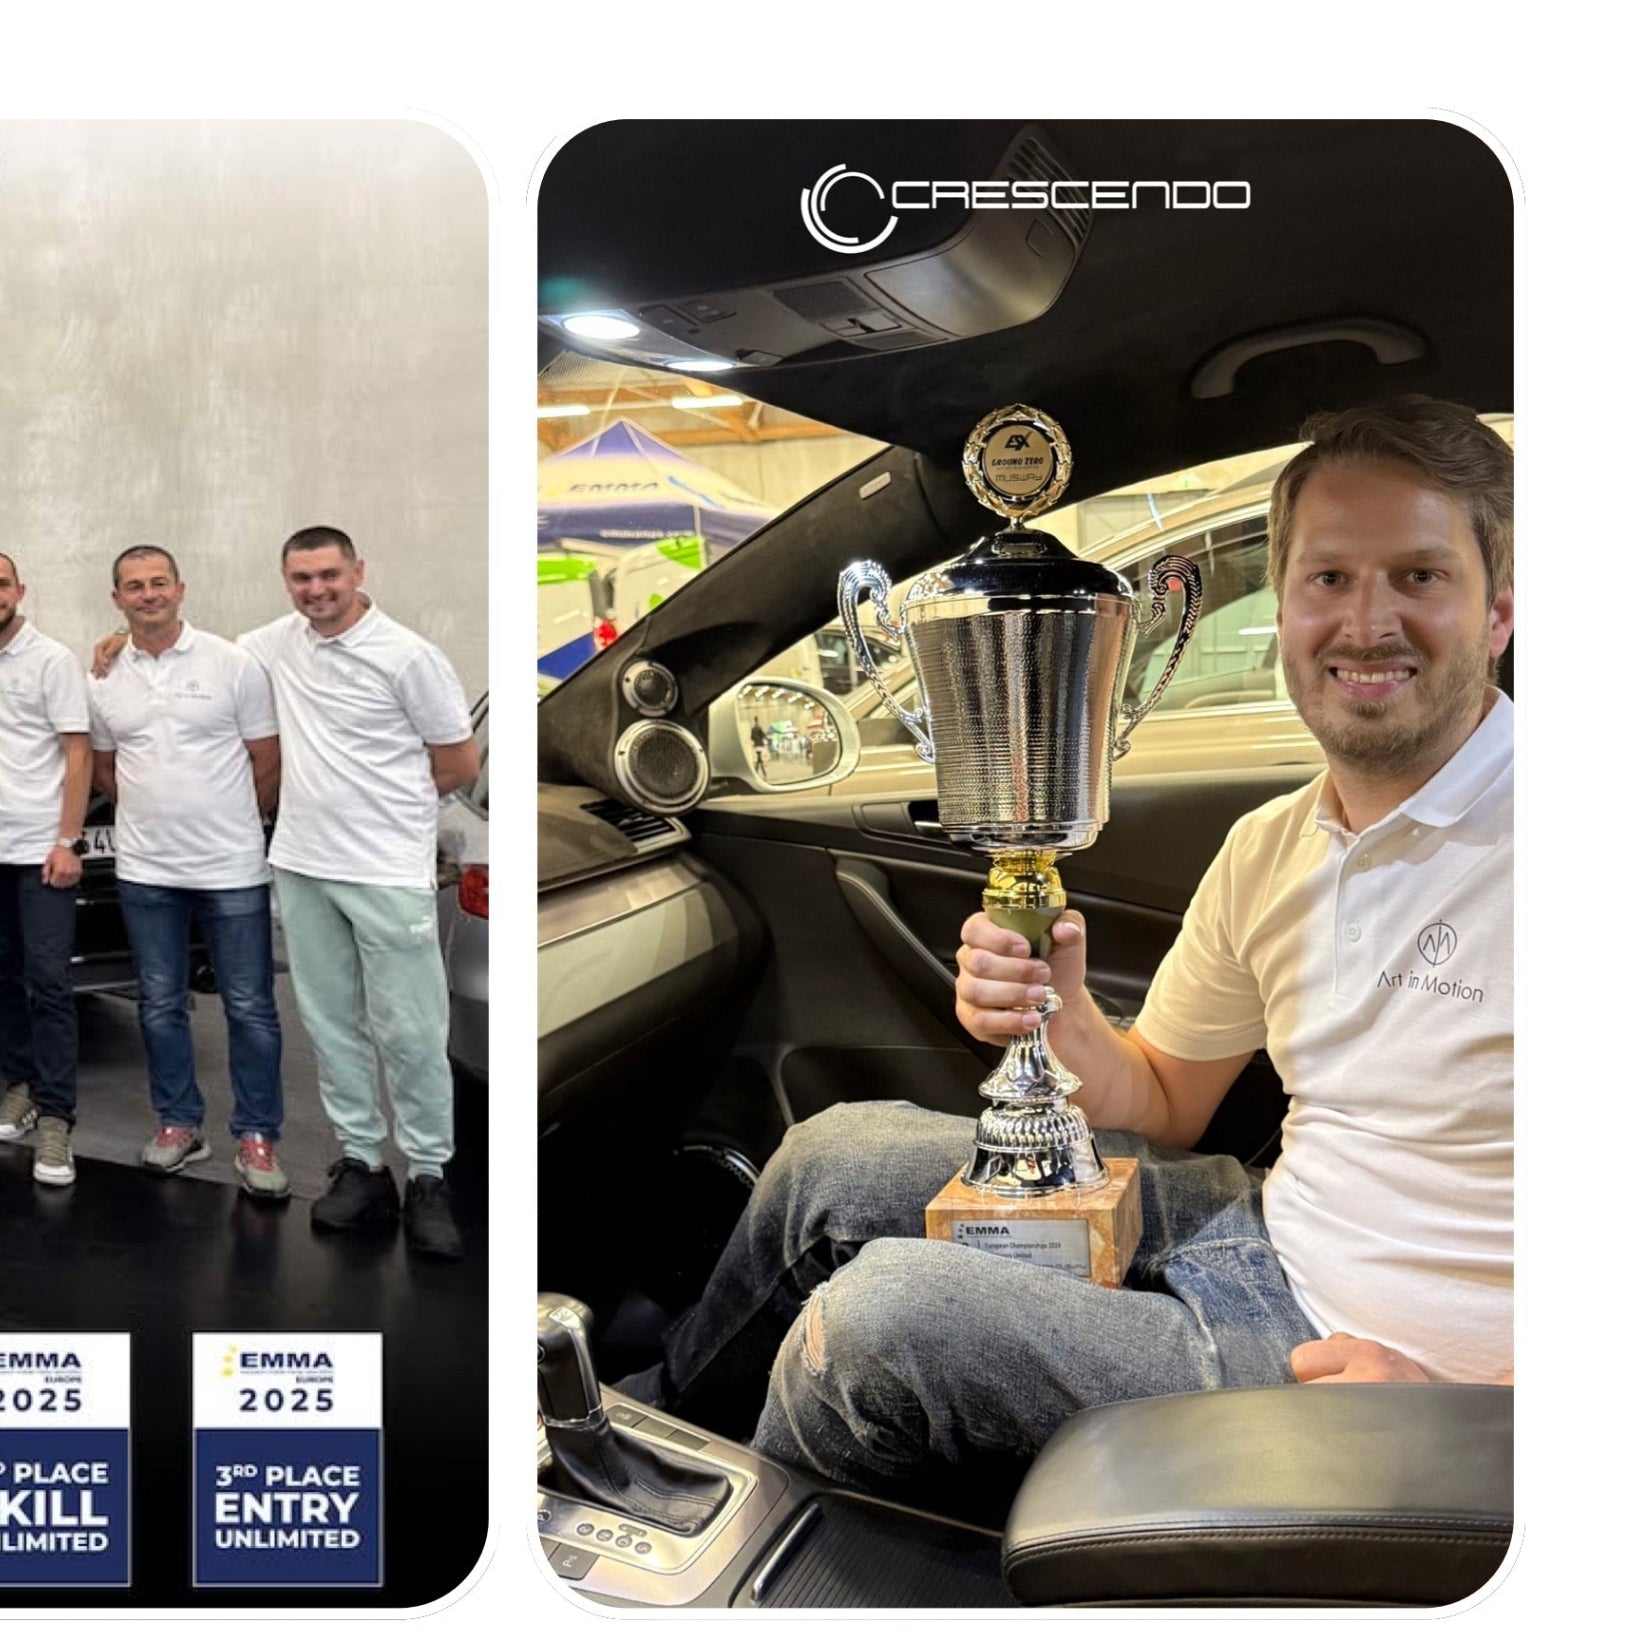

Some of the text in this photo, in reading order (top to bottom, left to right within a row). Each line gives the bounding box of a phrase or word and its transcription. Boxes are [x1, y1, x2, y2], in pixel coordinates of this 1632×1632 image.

[992, 457, 1044, 467] GROUND ZERO
[1377, 970, 1484, 1003] Art in Motion
[966, 1226, 1010, 1235] EMMA
